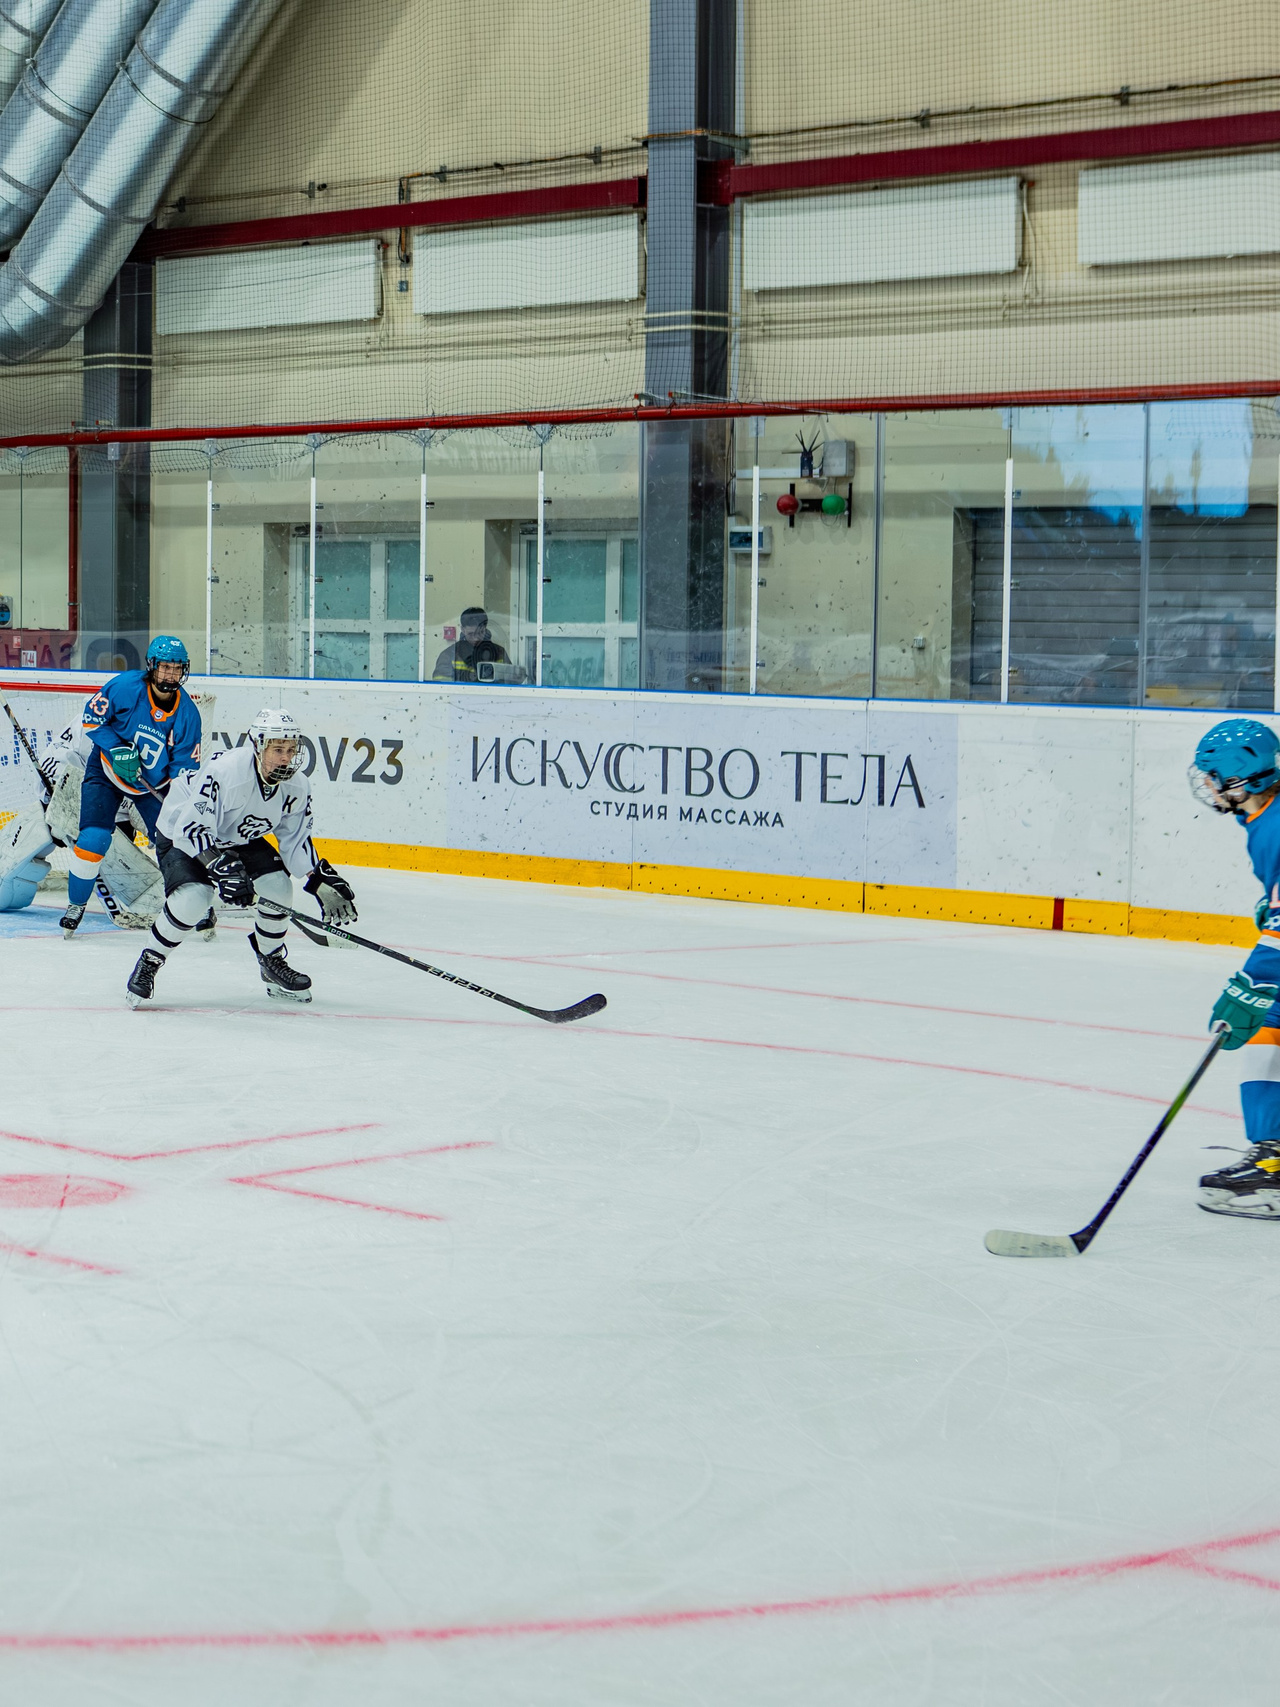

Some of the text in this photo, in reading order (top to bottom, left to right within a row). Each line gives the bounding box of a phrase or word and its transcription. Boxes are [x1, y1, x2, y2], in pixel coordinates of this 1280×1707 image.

[88, 691, 109, 716] 43
[472, 736, 926, 808] ИСКУССТВО ТЕЛА
[282, 794, 297, 813] K
[590, 801, 785, 828] СТУДИЯ МАССАЖА
